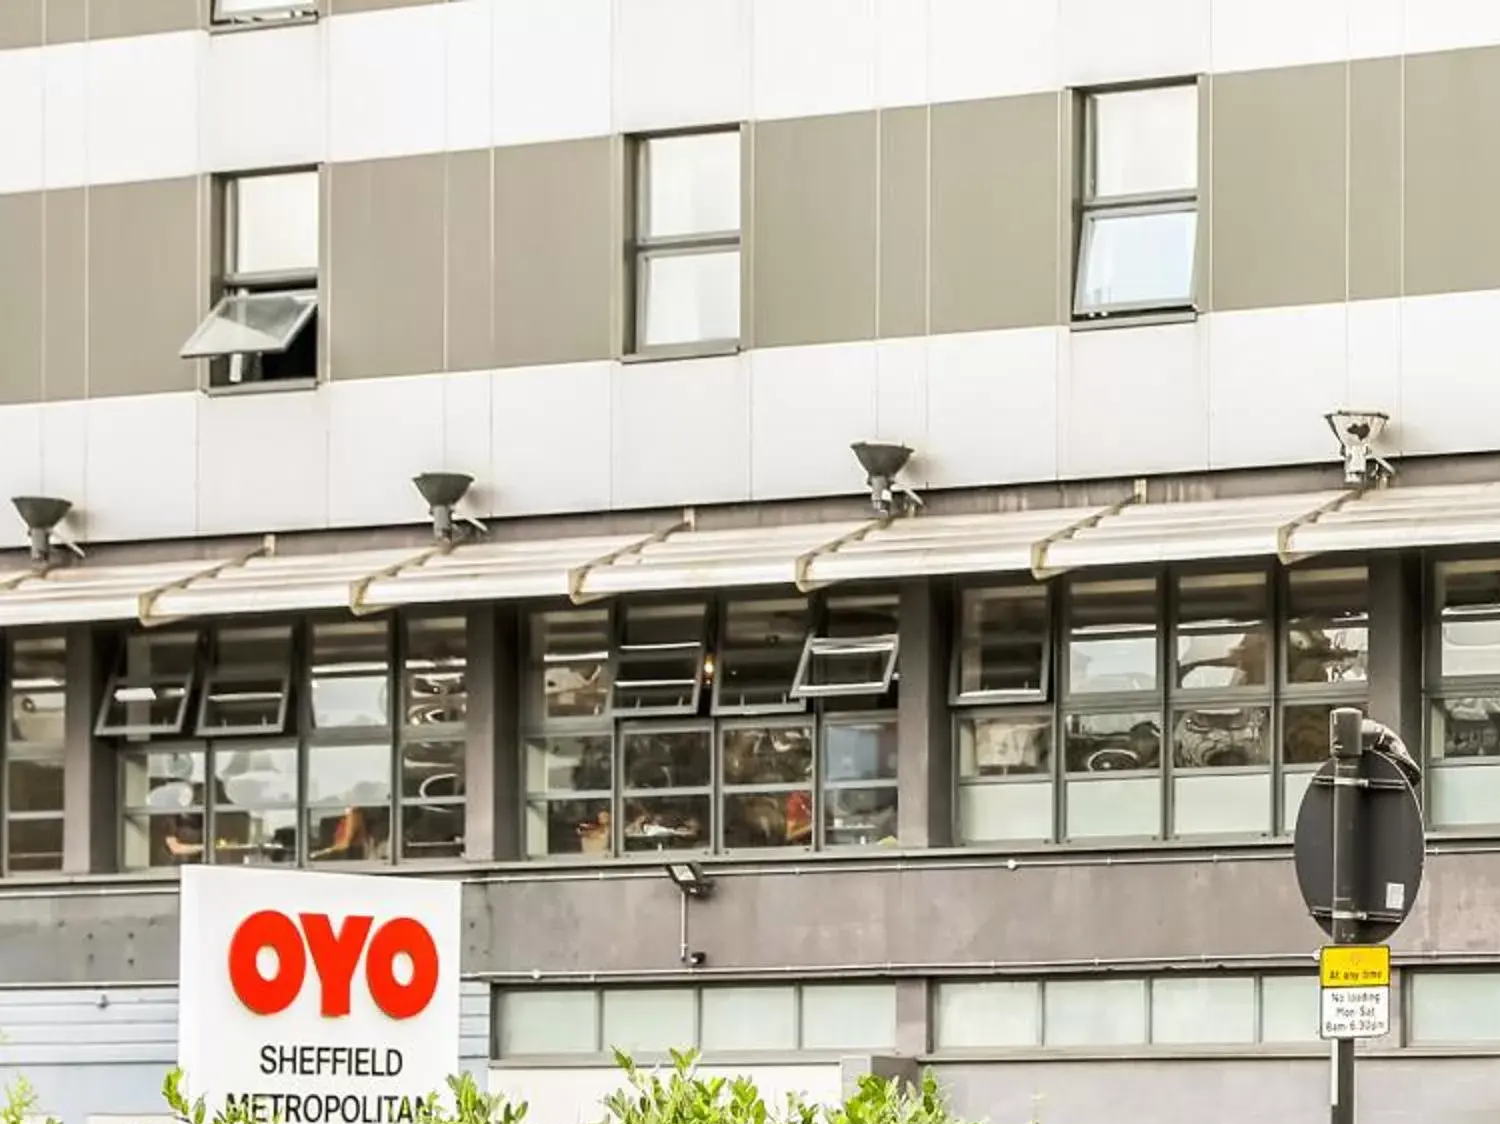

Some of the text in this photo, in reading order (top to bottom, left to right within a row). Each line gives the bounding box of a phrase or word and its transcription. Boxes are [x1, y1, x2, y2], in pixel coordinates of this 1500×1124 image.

[228, 909, 440, 1021] OYO
[1329, 968, 1383, 981] At any time
[1331, 991, 1381, 1005] No loading
[260, 1045, 404, 1077] SHEFFIELD
